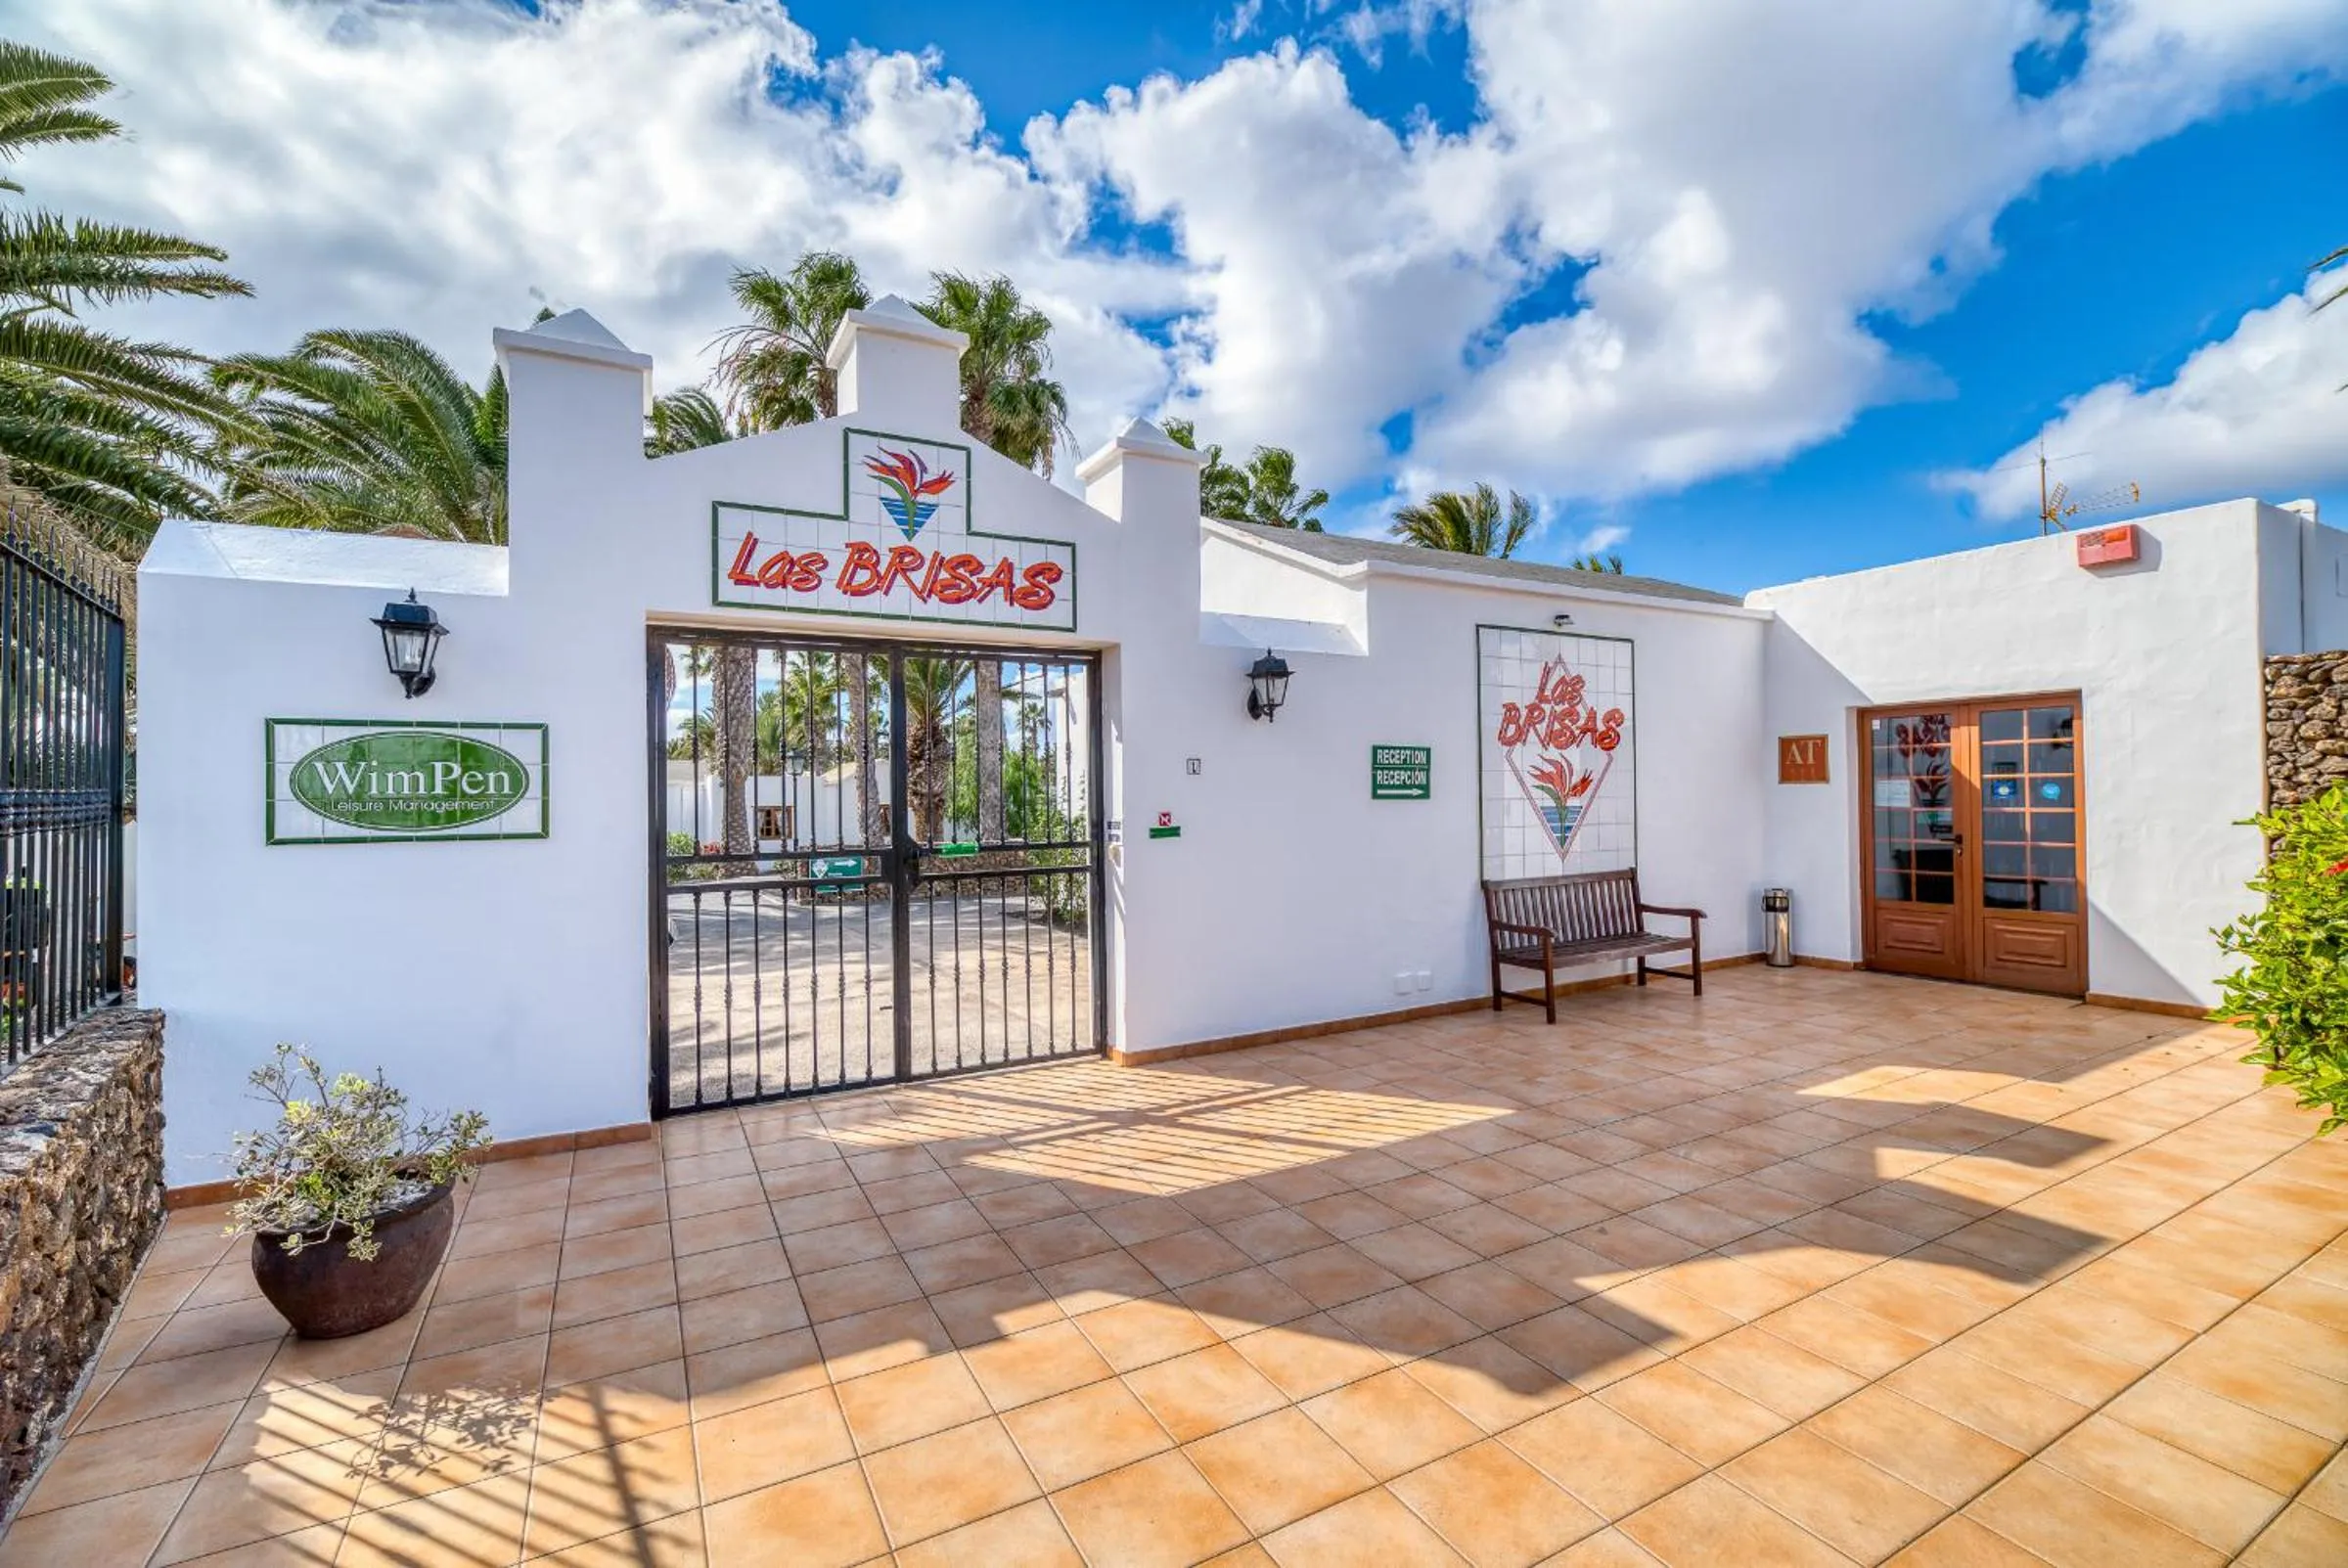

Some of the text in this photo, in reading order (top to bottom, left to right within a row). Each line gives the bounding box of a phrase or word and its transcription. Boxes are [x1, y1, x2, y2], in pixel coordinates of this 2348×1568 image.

[728, 531, 1063, 610] Las BRISAS
[1536, 661, 1586, 705] Las
[1498, 701, 1625, 751] BRISAS
[1377, 749, 1427, 764] RECEPTION
[1785, 739, 1822, 764] AT
[312, 760, 514, 795] WimPen
[1377, 767, 1427, 784] RECEPCIÓN
[331, 798, 495, 814] Leisure Management
